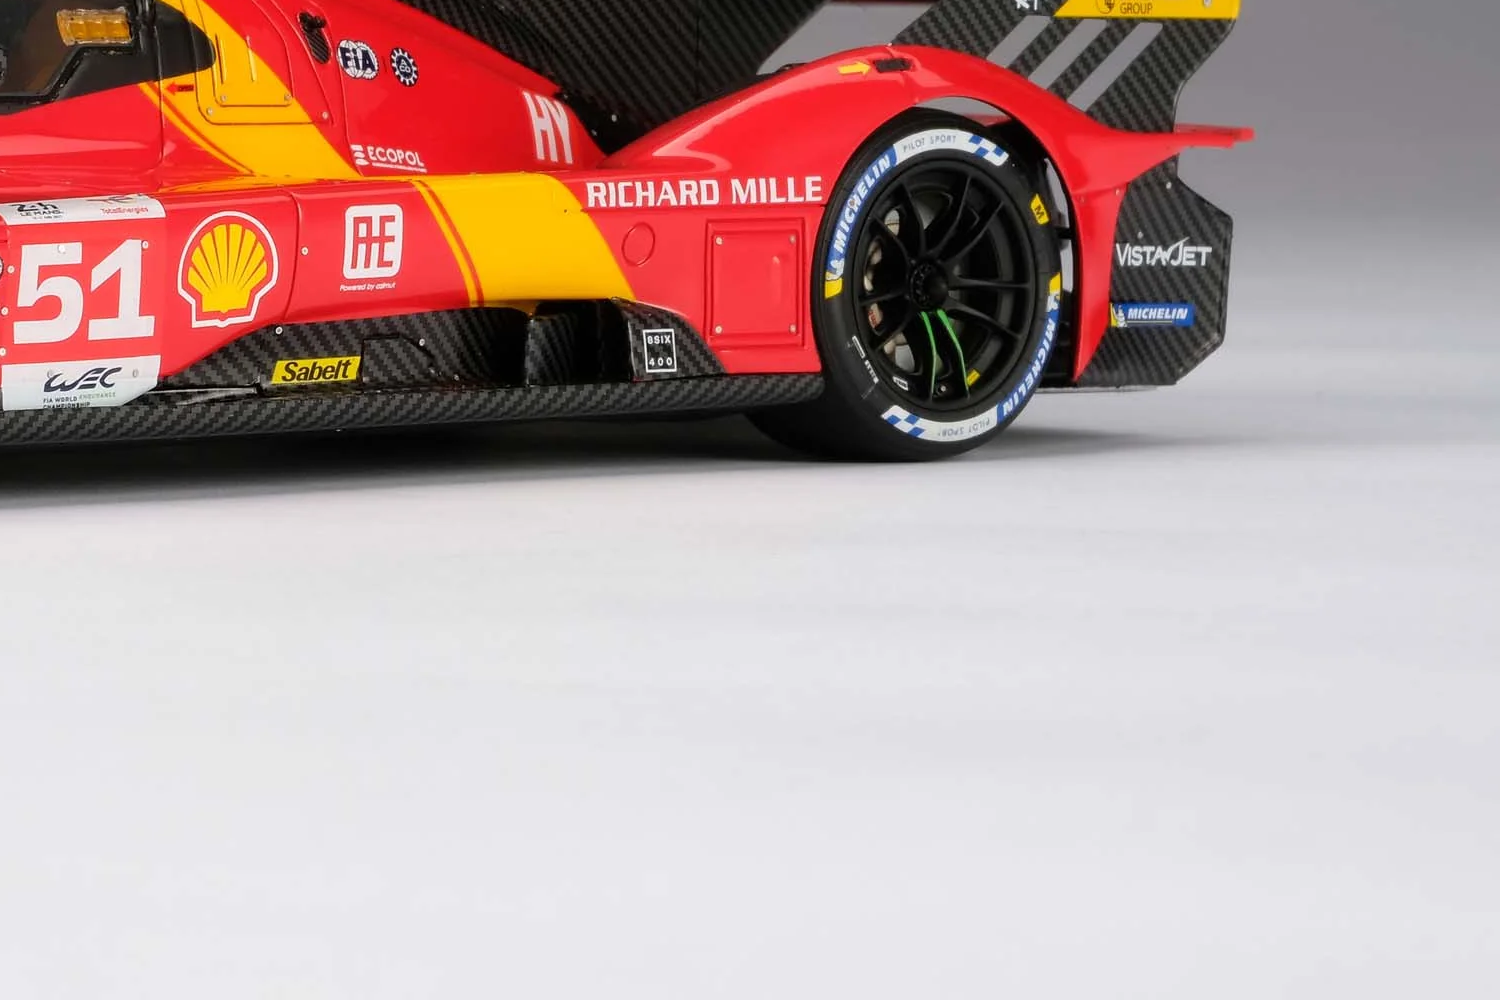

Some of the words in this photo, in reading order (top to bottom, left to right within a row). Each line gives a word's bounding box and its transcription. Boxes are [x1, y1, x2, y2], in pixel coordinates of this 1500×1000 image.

[1120, 3, 1153, 15] GROUP
[522, 90, 573, 165] HY
[366, 145, 425, 167] ECOPOL
[903, 137, 926, 153] PILOT
[930, 135, 957, 145] SPORT
[586, 179, 720, 208] RICHARD
[730, 176, 823, 205] MILLE
[833, 153, 891, 254] MICHELIN
[13, 239, 156, 345] 51
[1127, 307, 1189, 320] MICHELIN
[43, 367, 123, 393] WEC
[281, 359, 352, 382] Sabelt
[1003, 317, 1057, 417] MICHELIN
